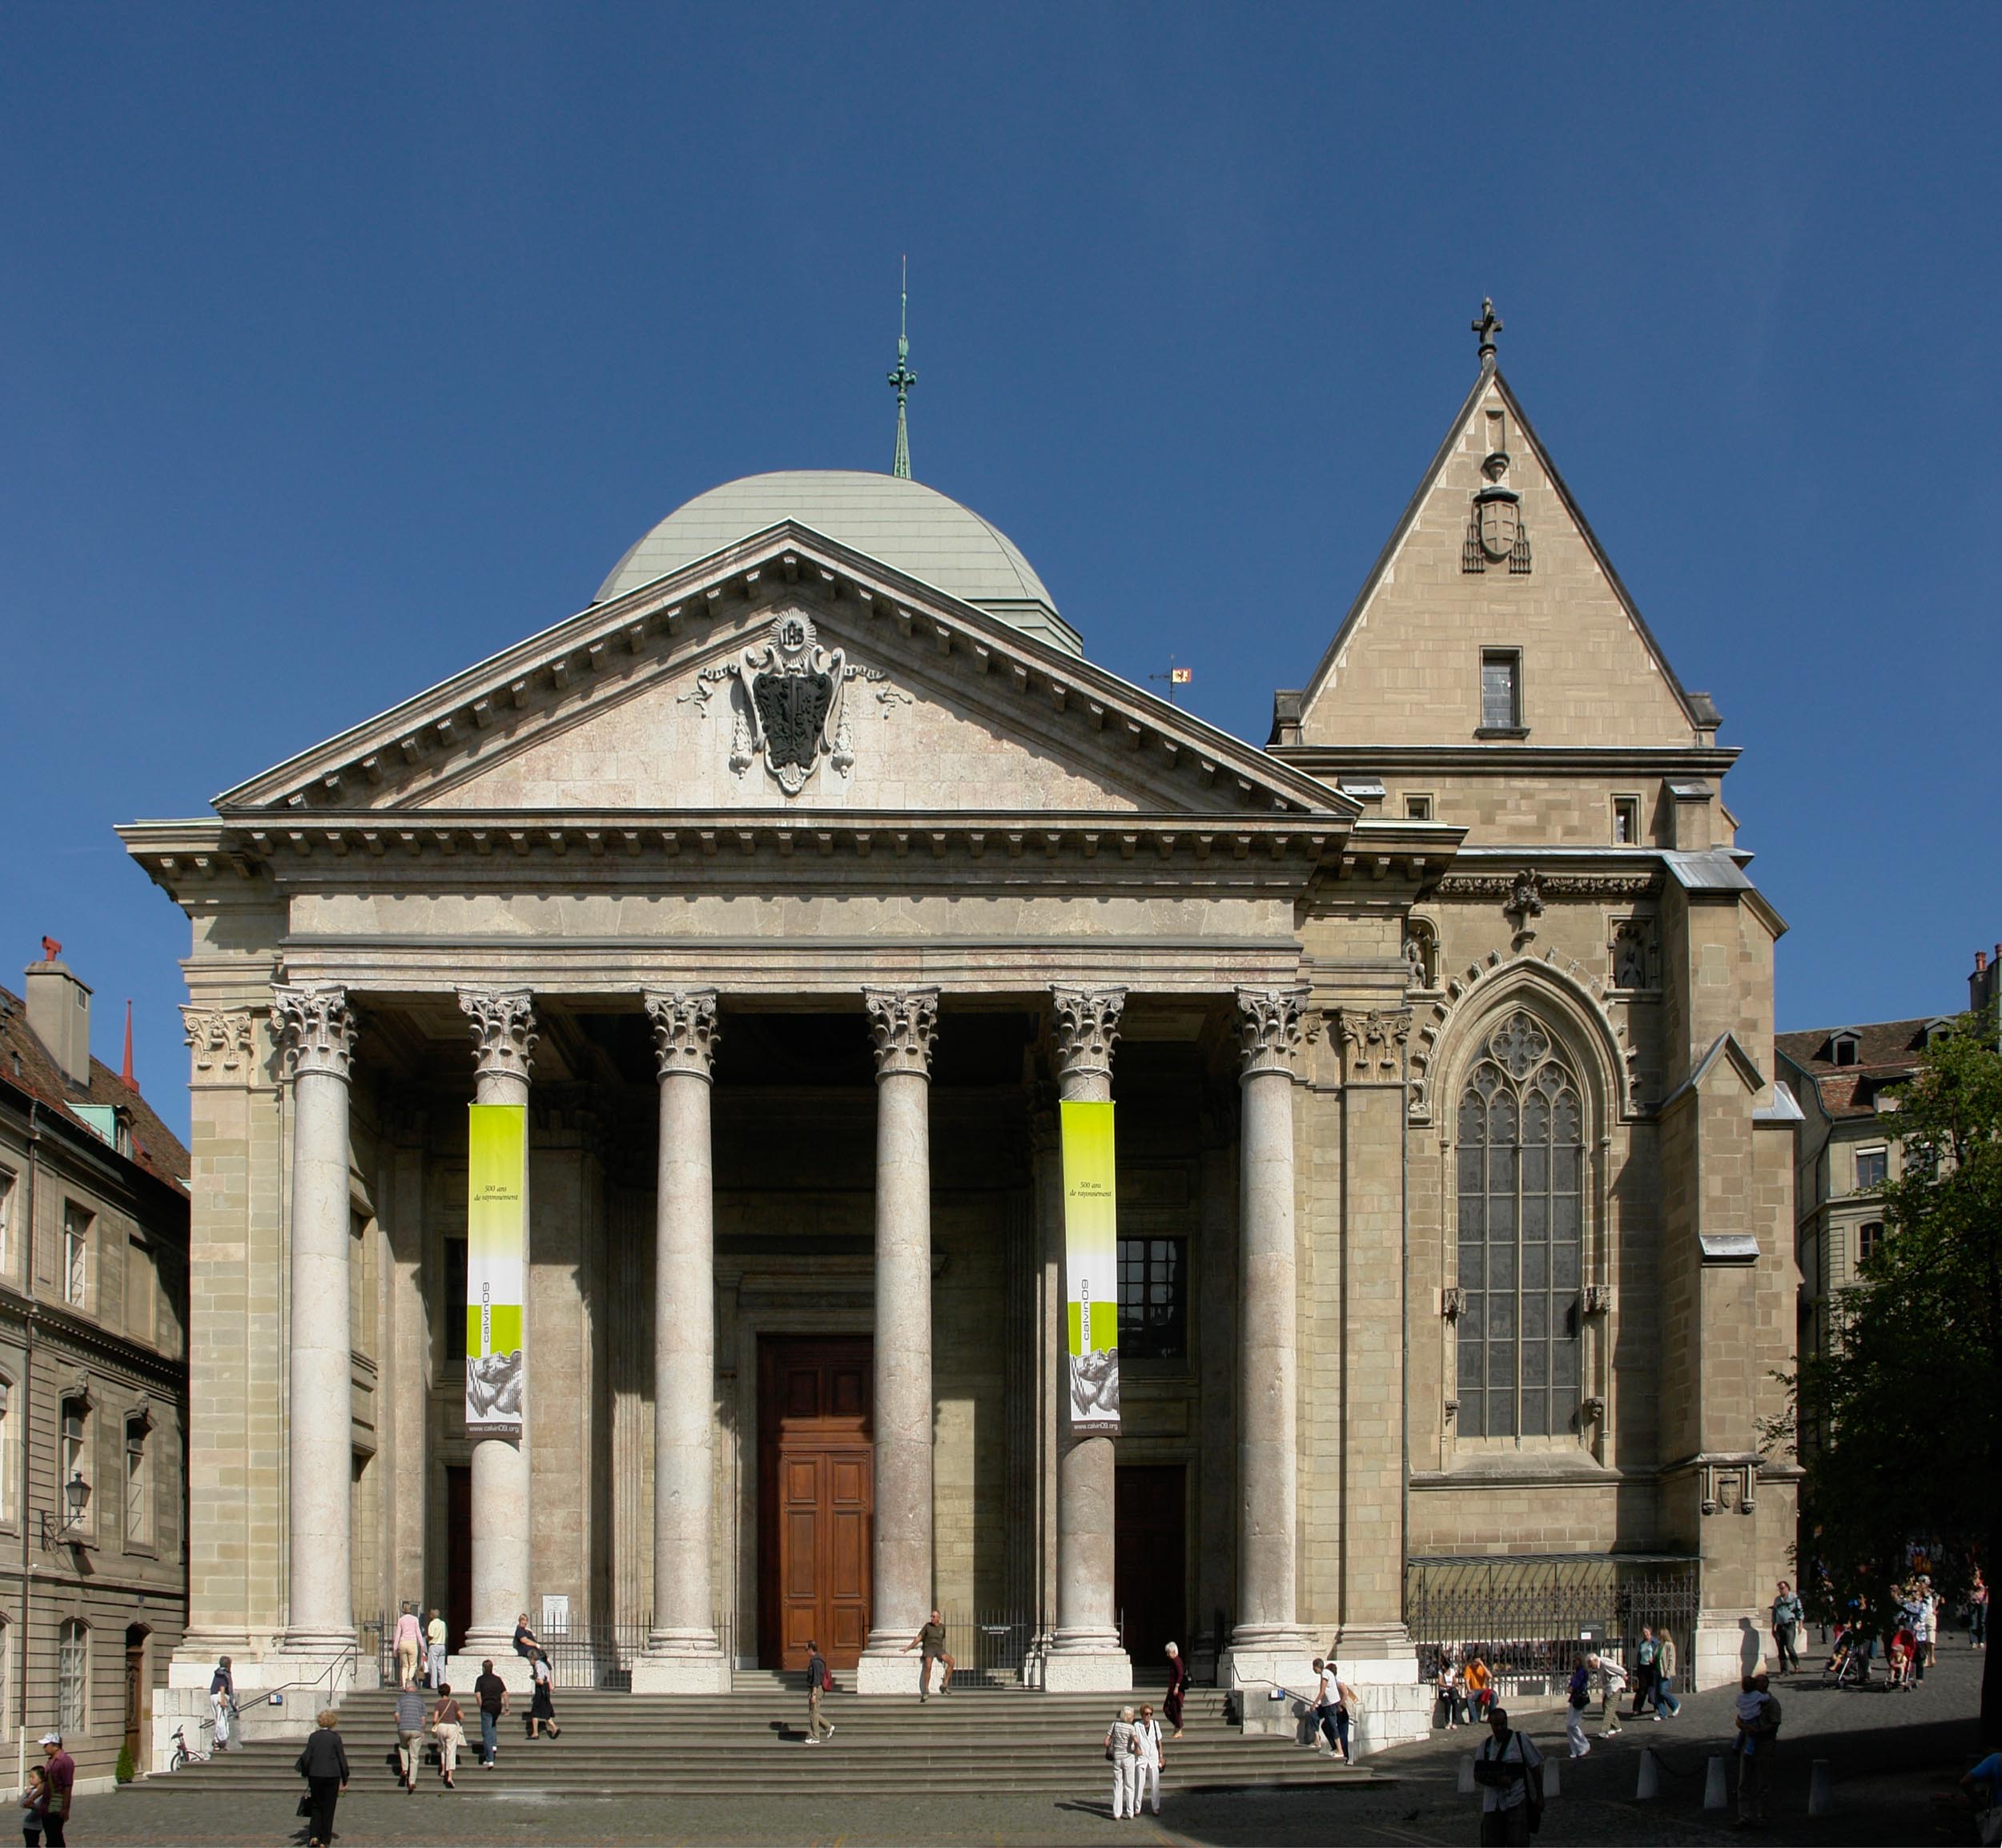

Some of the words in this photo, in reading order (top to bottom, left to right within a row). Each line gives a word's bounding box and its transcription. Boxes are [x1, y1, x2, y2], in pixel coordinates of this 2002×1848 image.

[1079, 1181, 1091, 1189] 500
[474, 1193, 481, 1201] de
[1077, 1191, 1112, 1199] rayonnement
[482, 1281, 490, 1344] calvin09
[1081, 1279, 1090, 1341] calvin09
[468, 1424, 519, 1434] www.calvin09.org
[1074, 1421, 1118, 1431] www.calvin09.org
